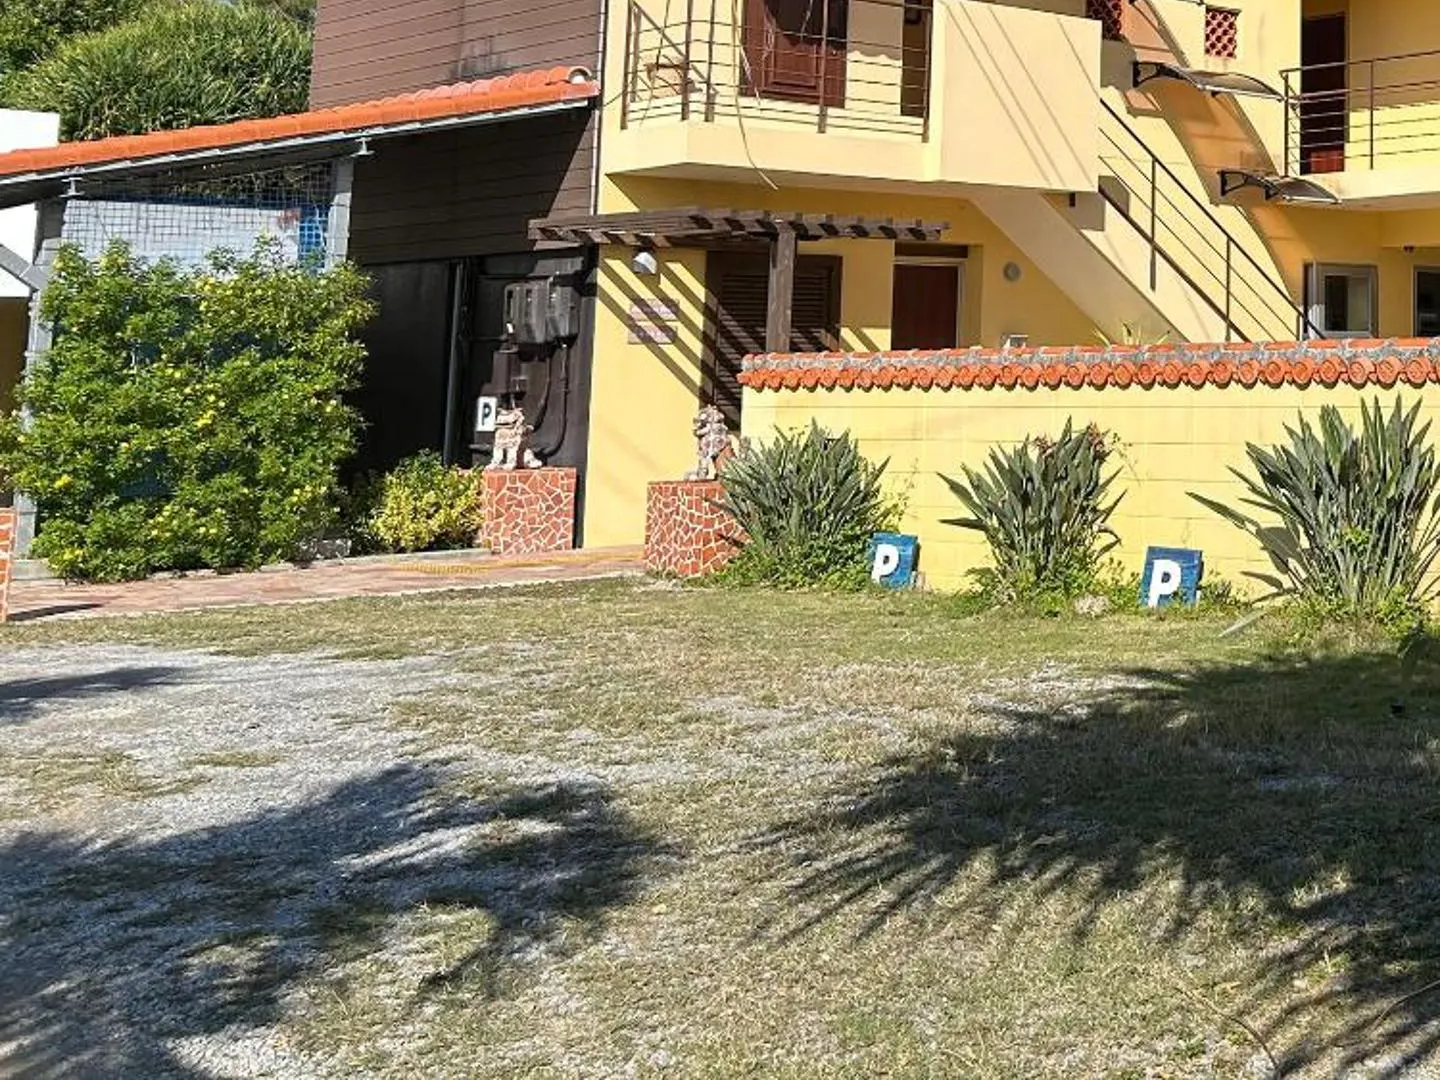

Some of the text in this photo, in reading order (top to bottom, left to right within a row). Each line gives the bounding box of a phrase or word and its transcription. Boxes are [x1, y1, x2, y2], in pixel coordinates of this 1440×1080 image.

[481, 402, 492, 426] P
[871, 543, 899, 584] P
[1148, 559, 1181, 608] P
